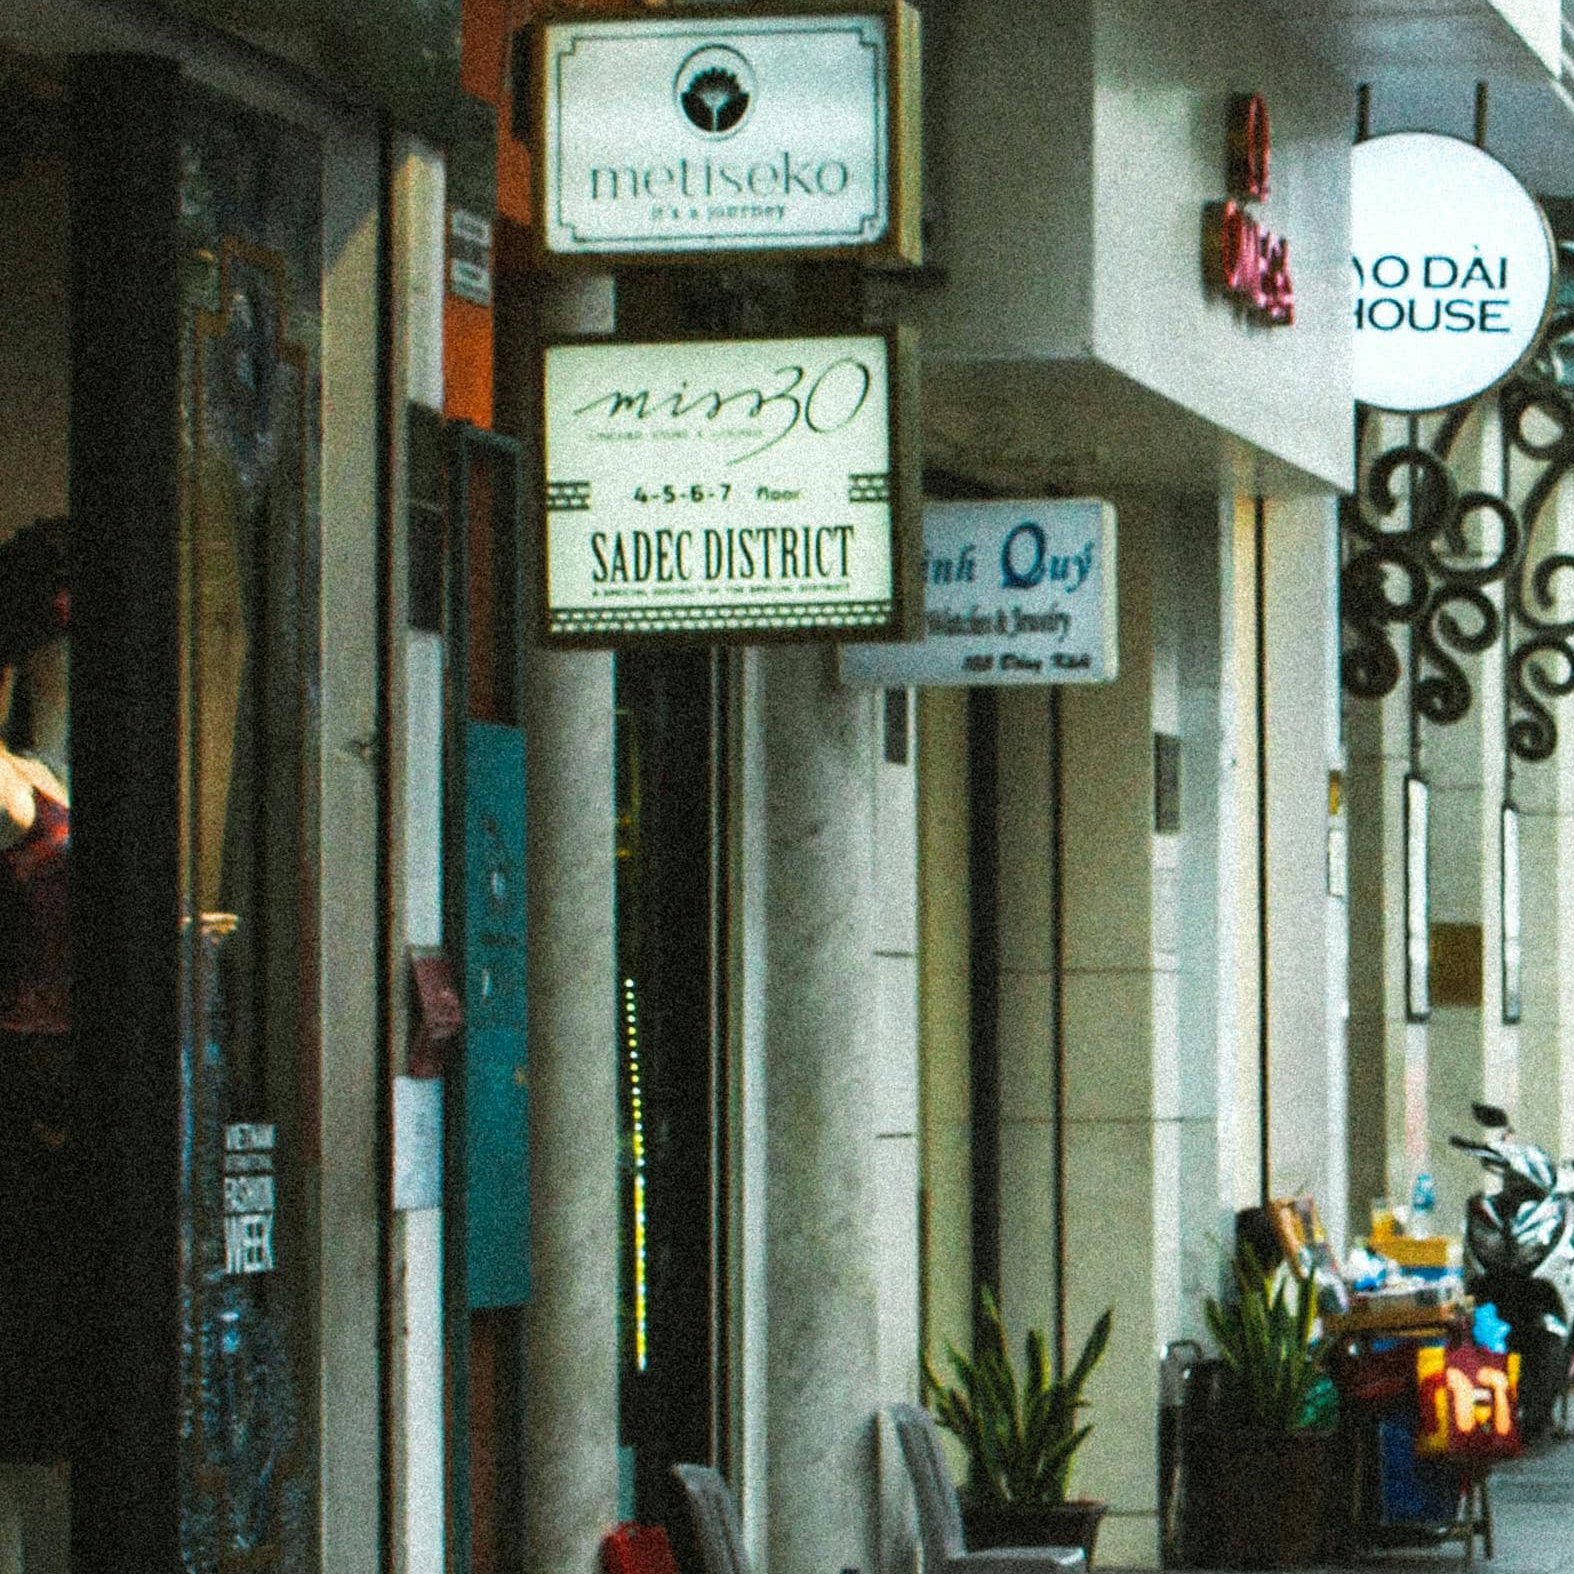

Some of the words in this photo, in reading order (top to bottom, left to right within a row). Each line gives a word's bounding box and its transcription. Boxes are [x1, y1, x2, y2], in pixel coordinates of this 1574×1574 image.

[590, 150, 849, 200] metiseko
[1423, 243, 1508, 290] DÀI
[591, 528, 693, 584] SADEC
[704, 524, 855, 580] DISTRICT
